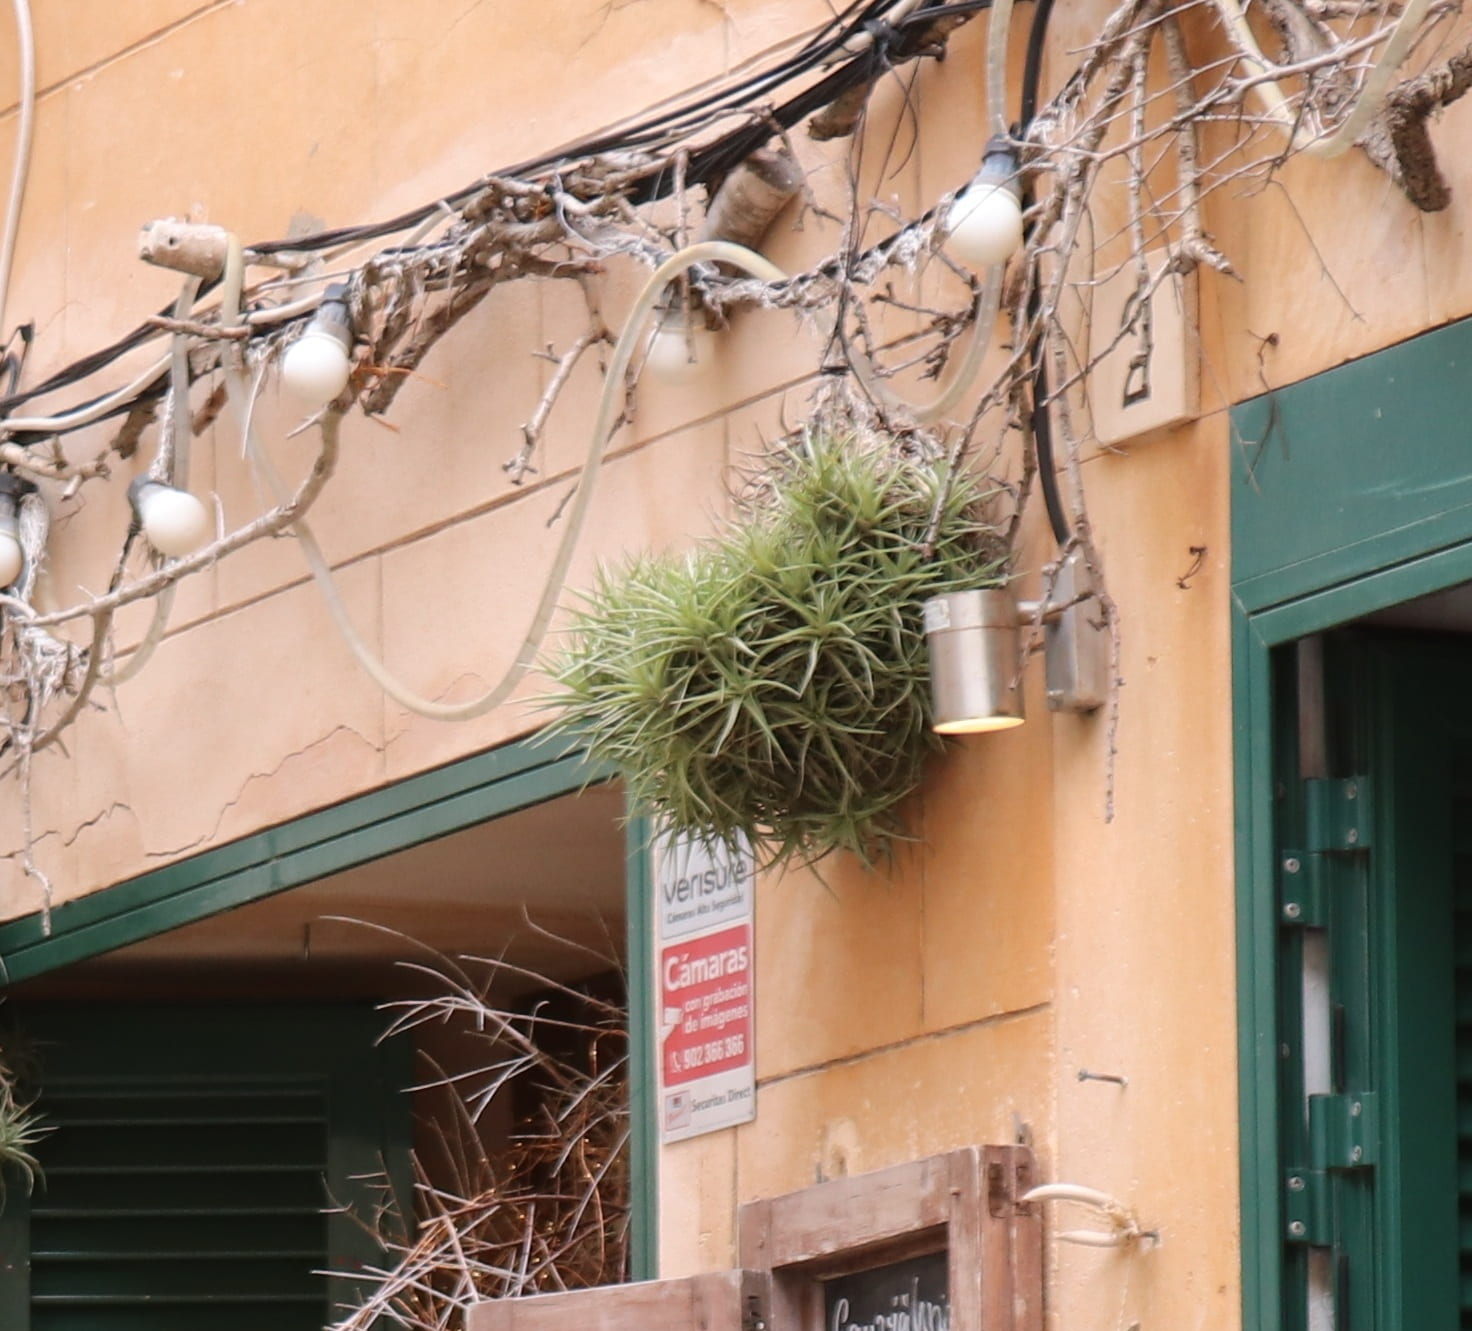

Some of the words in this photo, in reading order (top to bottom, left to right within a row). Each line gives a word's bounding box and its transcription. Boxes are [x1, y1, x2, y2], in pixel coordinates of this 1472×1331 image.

[664, 945, 748, 990] Cámaras
[684, 1000, 702, 1013] con
[684, 1015, 698, 1034] de
